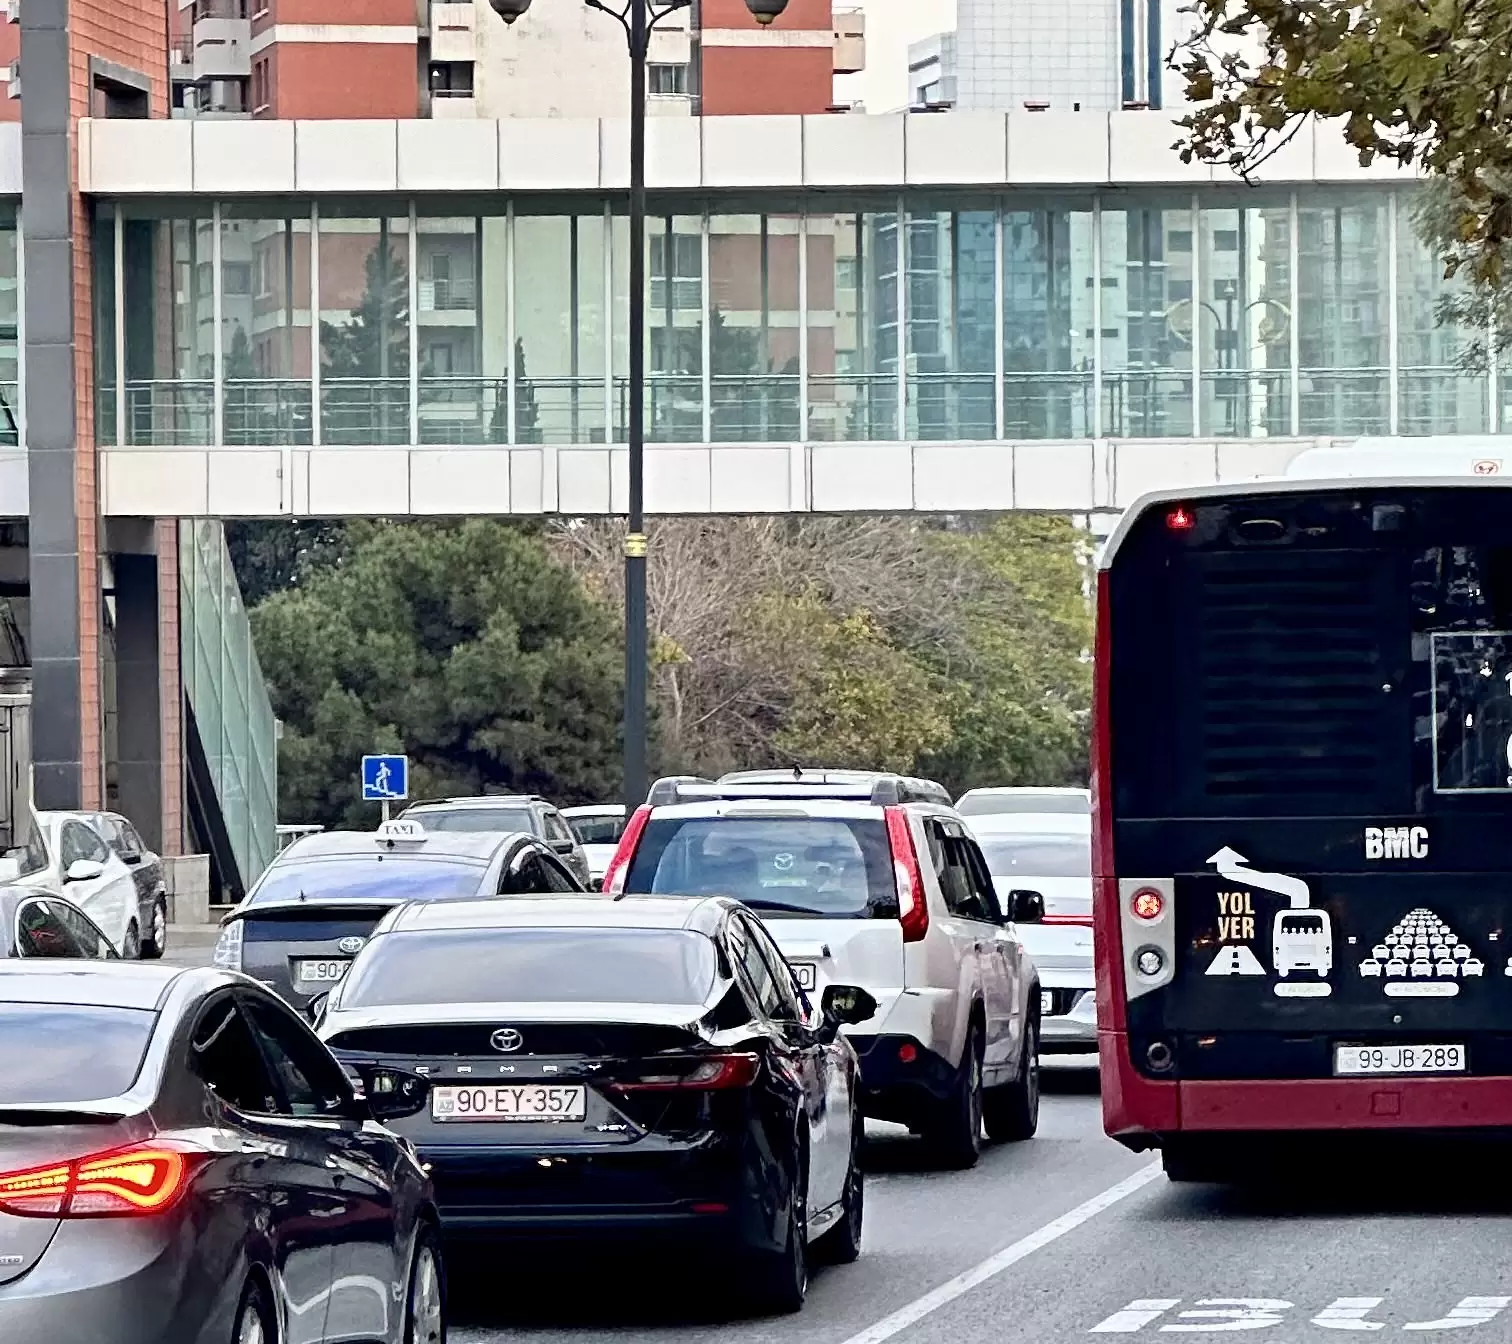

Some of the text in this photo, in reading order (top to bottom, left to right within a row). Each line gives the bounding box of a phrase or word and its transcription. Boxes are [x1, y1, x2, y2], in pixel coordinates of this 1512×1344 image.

[1365, 826, 1429, 859] BMC
[1217, 892, 1256, 915] YOL
[1217, 916, 1255, 941] VER
[1359, 1047, 1459, 1068] 99-JB-289
[457, 1089, 579, 1113] 90-EY-357
